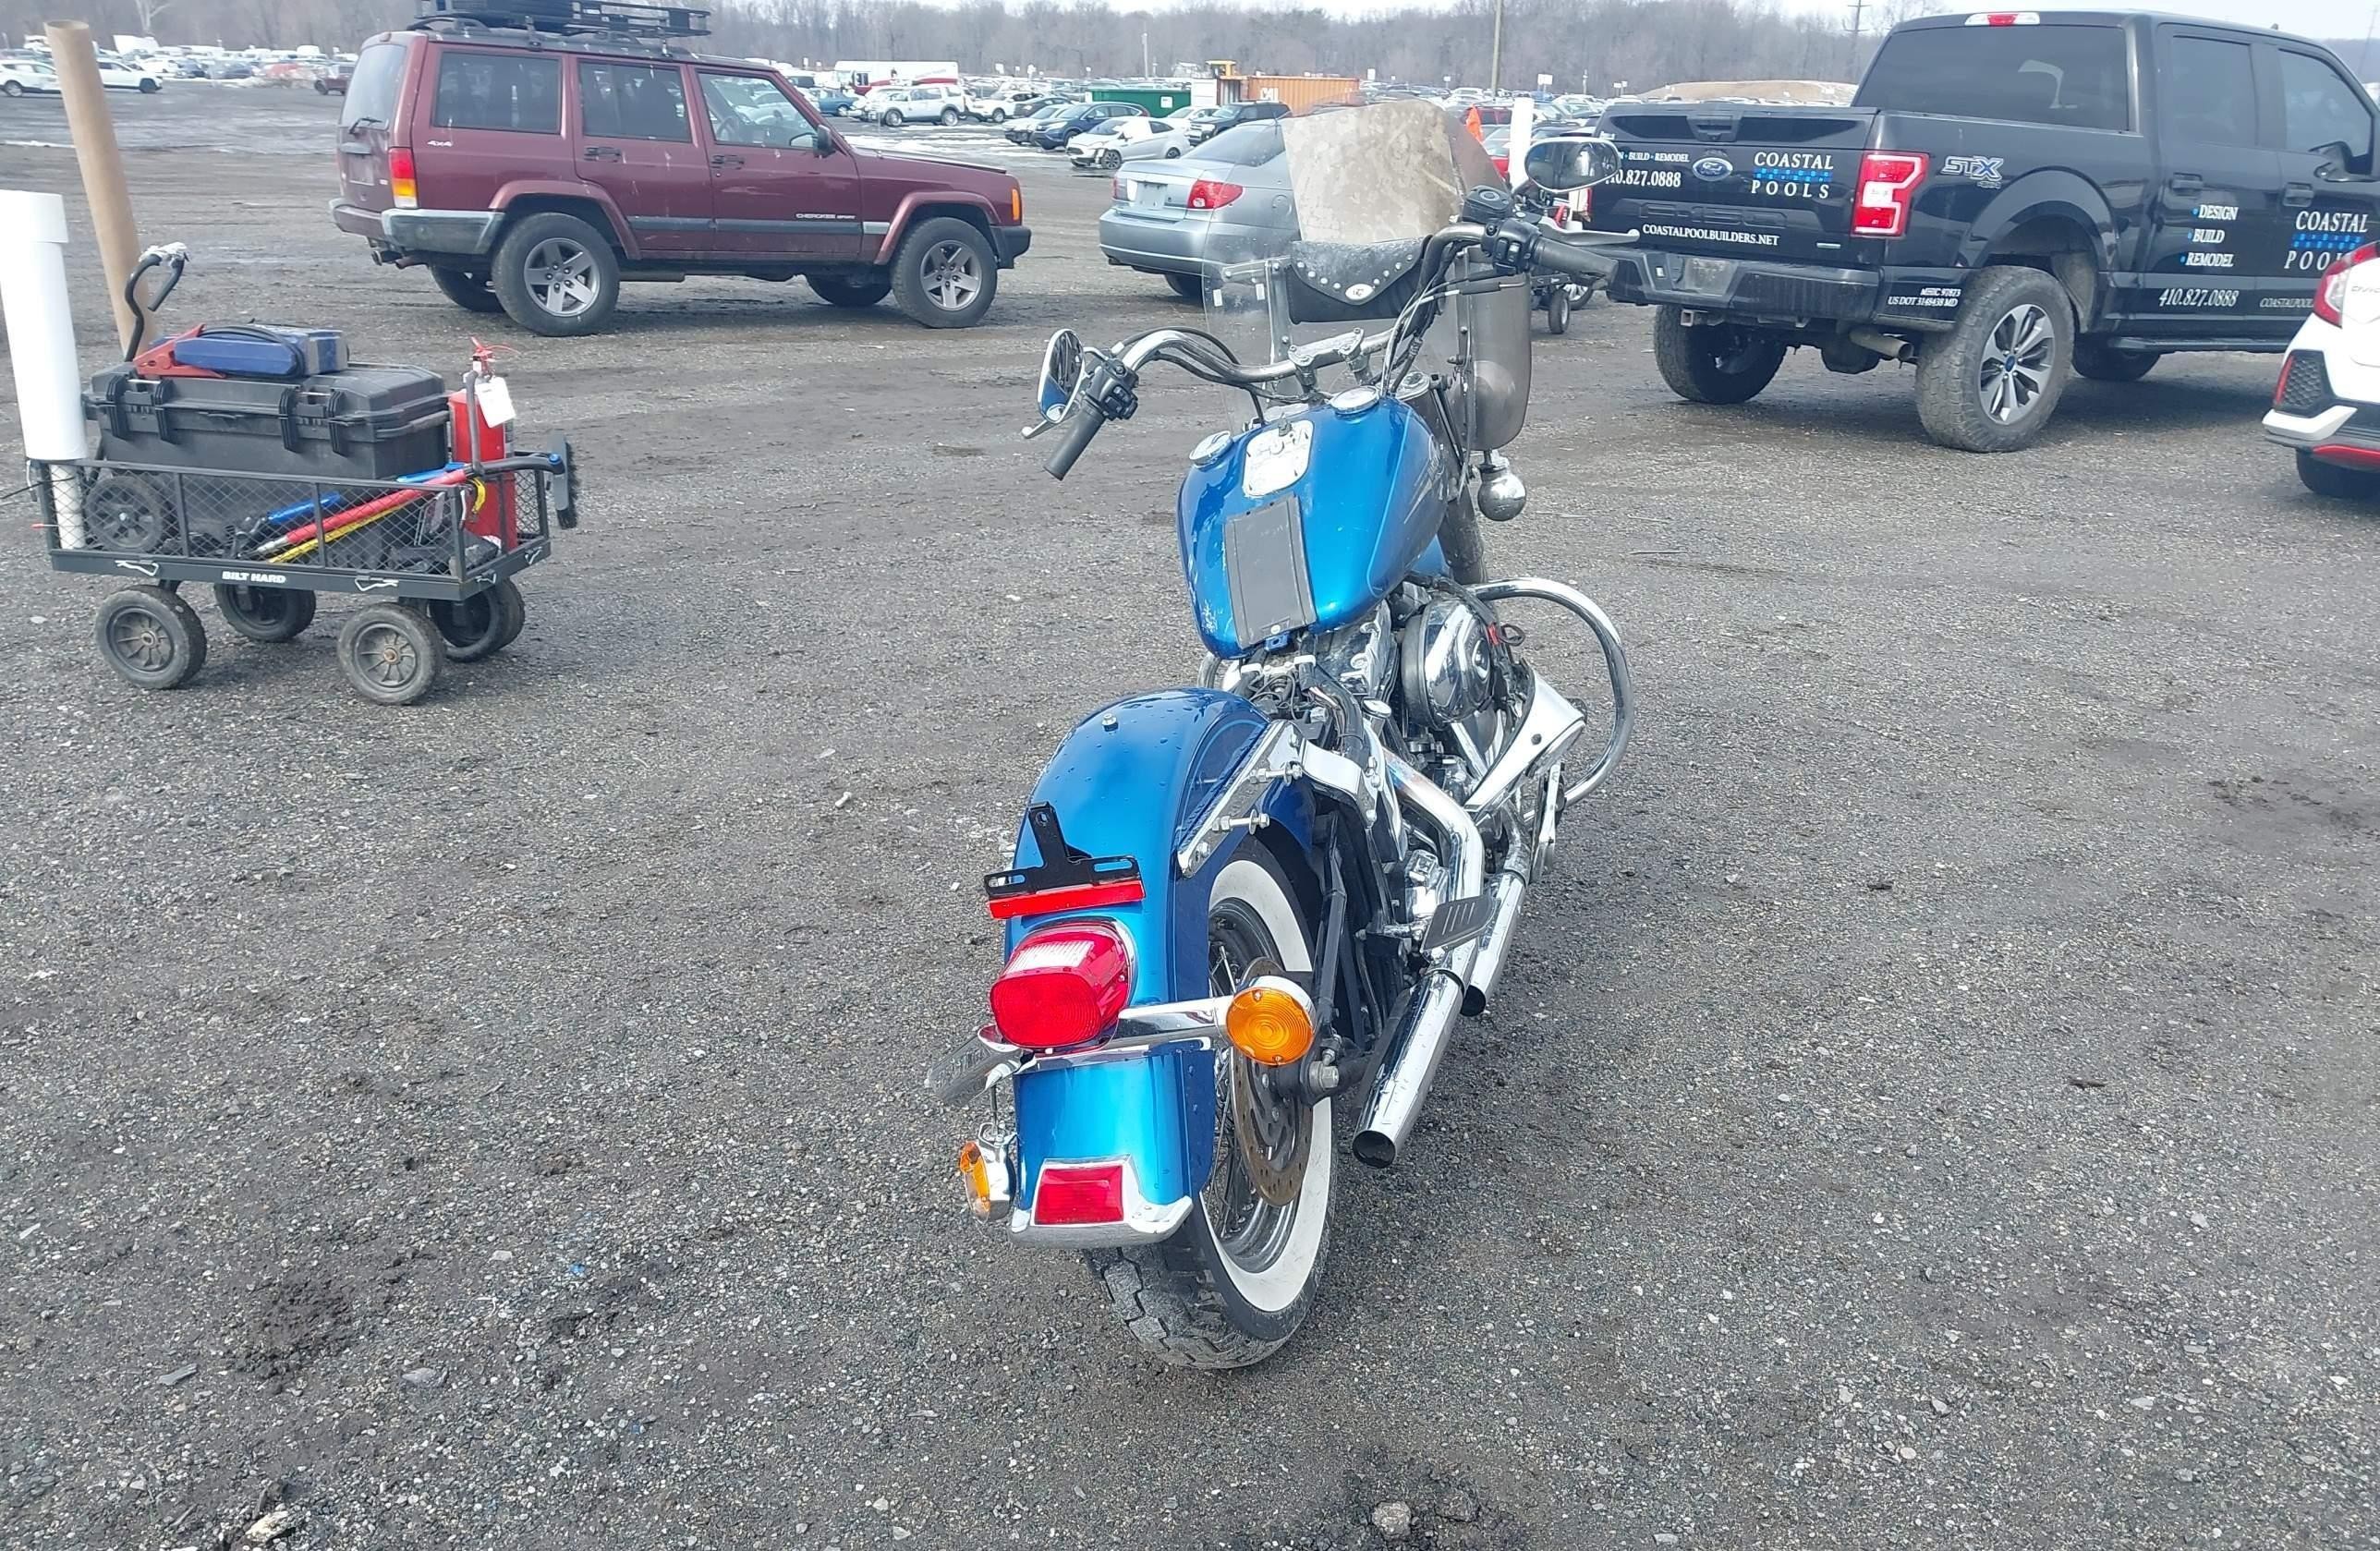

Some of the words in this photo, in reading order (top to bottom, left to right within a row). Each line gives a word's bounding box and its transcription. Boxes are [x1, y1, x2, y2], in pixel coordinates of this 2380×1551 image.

[1628, 151, 1650, 161] BUILD
[1654, 152, 1690, 163] REMODEL
[1754, 151, 1834, 170] COASTAL
[1940, 155, 2004, 181] STX
[1606, 169, 1682, 188] 0.827.0888
[1751, 179, 1830, 200] POOLS
[2198, 204, 2239, 221] DESIGN
[2295, 211, 2369, 233] COASTAL
[1642, 224, 1779, 247] COASTALPOOLBUILDERS.NET
[2192, 228, 2226, 244] BUILD
[2185, 252, 2234, 268] REMODEL
[2284, 250, 2343, 271] POO
[1899, 297, 1917, 306] DOT
[2158, 287, 2240, 308] 410.827.0888
[222, 571, 249, 581] BILT
[250, 573, 286, 584] HARD
